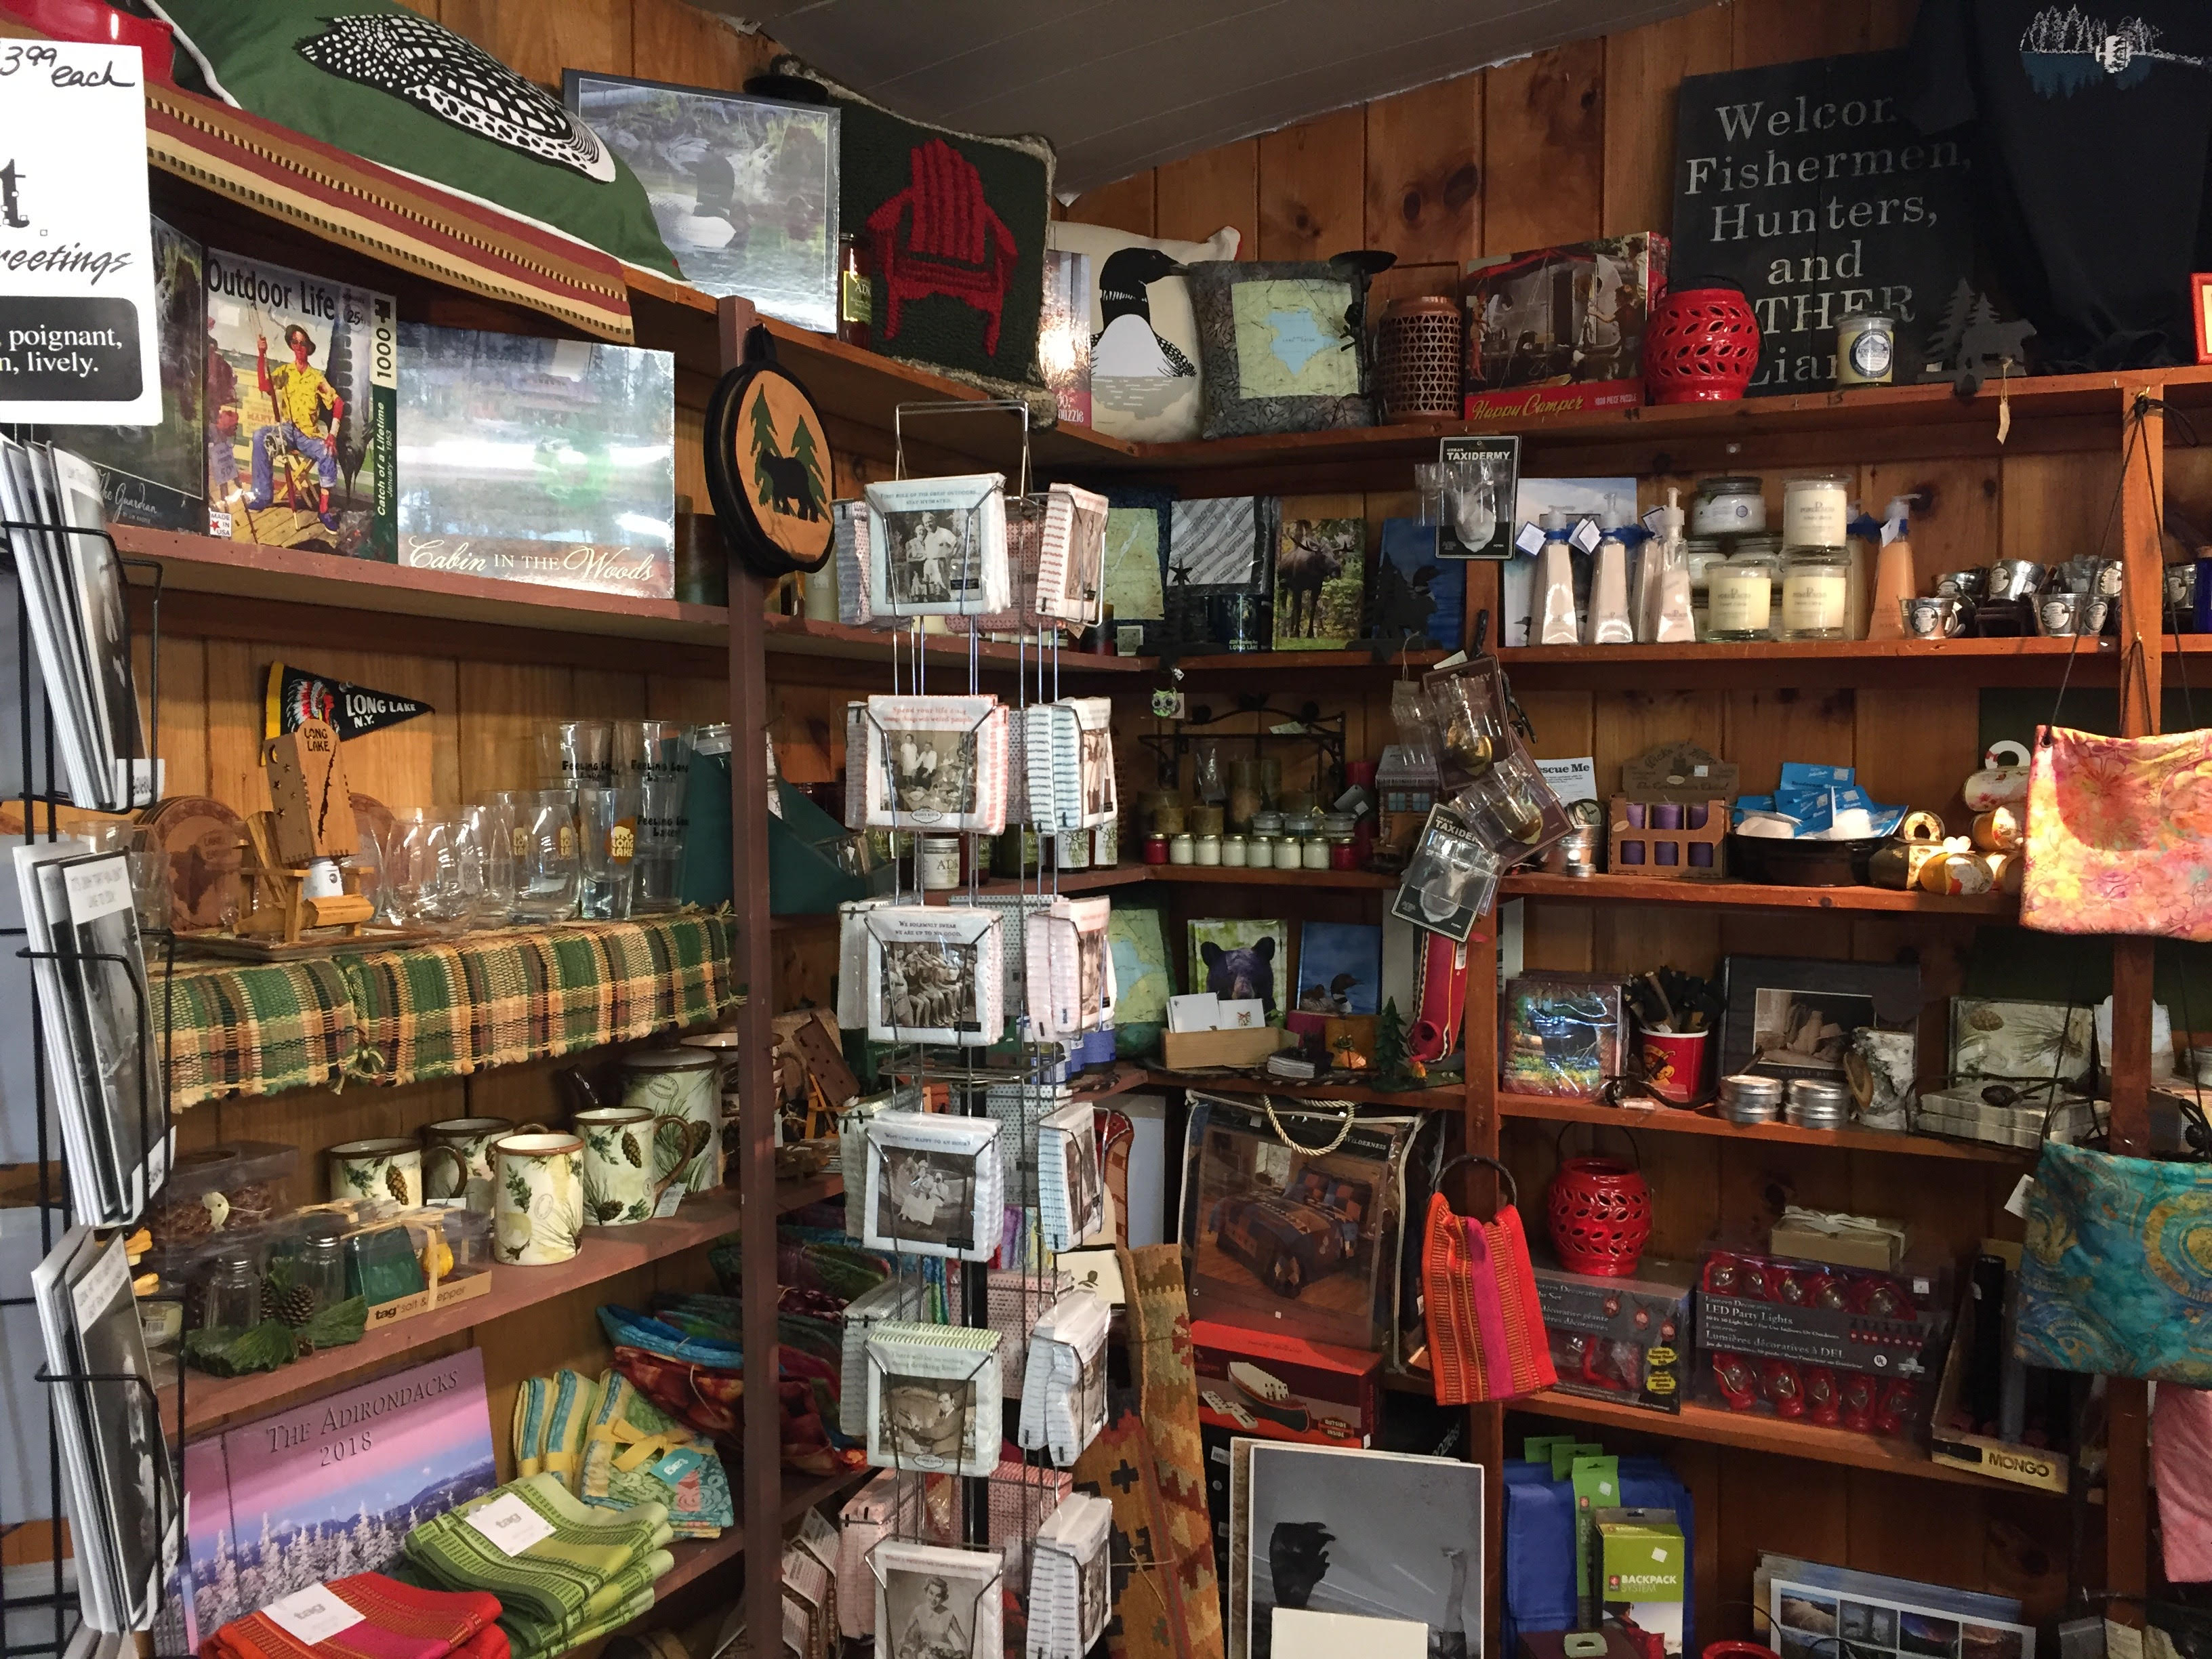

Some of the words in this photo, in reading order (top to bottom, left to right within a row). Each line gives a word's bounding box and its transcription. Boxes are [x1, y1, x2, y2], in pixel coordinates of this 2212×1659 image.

[51, 60, 135, 87] each
[1684, 141, 1972, 195] Fishermen,
[1710, 194, 1938, 243] Hunters,
[1767, 239, 1864, 285] and
[207, 258, 291, 309] Outdoor
[301, 280, 335, 320] Life
[9, 324, 123, 351] poignant,
[28, 351, 99, 377] lively.
[376, 327, 392, 378] 1000
[1473, 399, 1522, 420] Happy
[1522, 394, 1584, 417] Camper
[377, 402, 385, 451] Lifetime
[1446, 451, 1511, 460] TAXIDERMY
[377, 462, 385, 477] of
[386, 462, 394, 498] January
[377, 482, 386, 516] Catch
[211, 513, 230, 521] MADE
[409, 535, 487, 571] Cabin
[494, 554, 514, 568] IN
[521, 556, 560, 570] THE
[563, 546, 654, 581] Woods
[346, 694, 386, 717] LONG
[389, 701, 416, 712] LAKE
[304, 728, 329, 739] LONG
[354, 714, 375, 729] N.Y.
[307, 741, 331, 752] LAKE
[1570, 763, 1590, 772] Me
[612, 839, 634, 847] LONG
[613, 848, 633, 857] LAKE
[401, 1299, 418, 1314] salt
[420, 1296, 428, 1307] &
[436, 1286, 468, 1302] epper
[1705, 1303, 1729, 1315] LED
[1732, 1307, 1757, 1321] Party
[1762, 1311, 1794, 1325] Lights
[1753, 1337, 1809, 1355] décoratives
[266, 1422, 310, 1454] THE
[320, 1370, 458, 1435] ADIRONDACKS
[1324, 1419, 1347, 1428] OUTSIDE
[1327, 1429, 1345, 1438] INSIDE
[320, 1431, 373, 1467] 2018
[1988, 1452, 2050, 1478] MONGO
[1620, 1575, 1677, 1584] BACKPACK
[1620, 1583, 1656, 1593] SYSTEM
